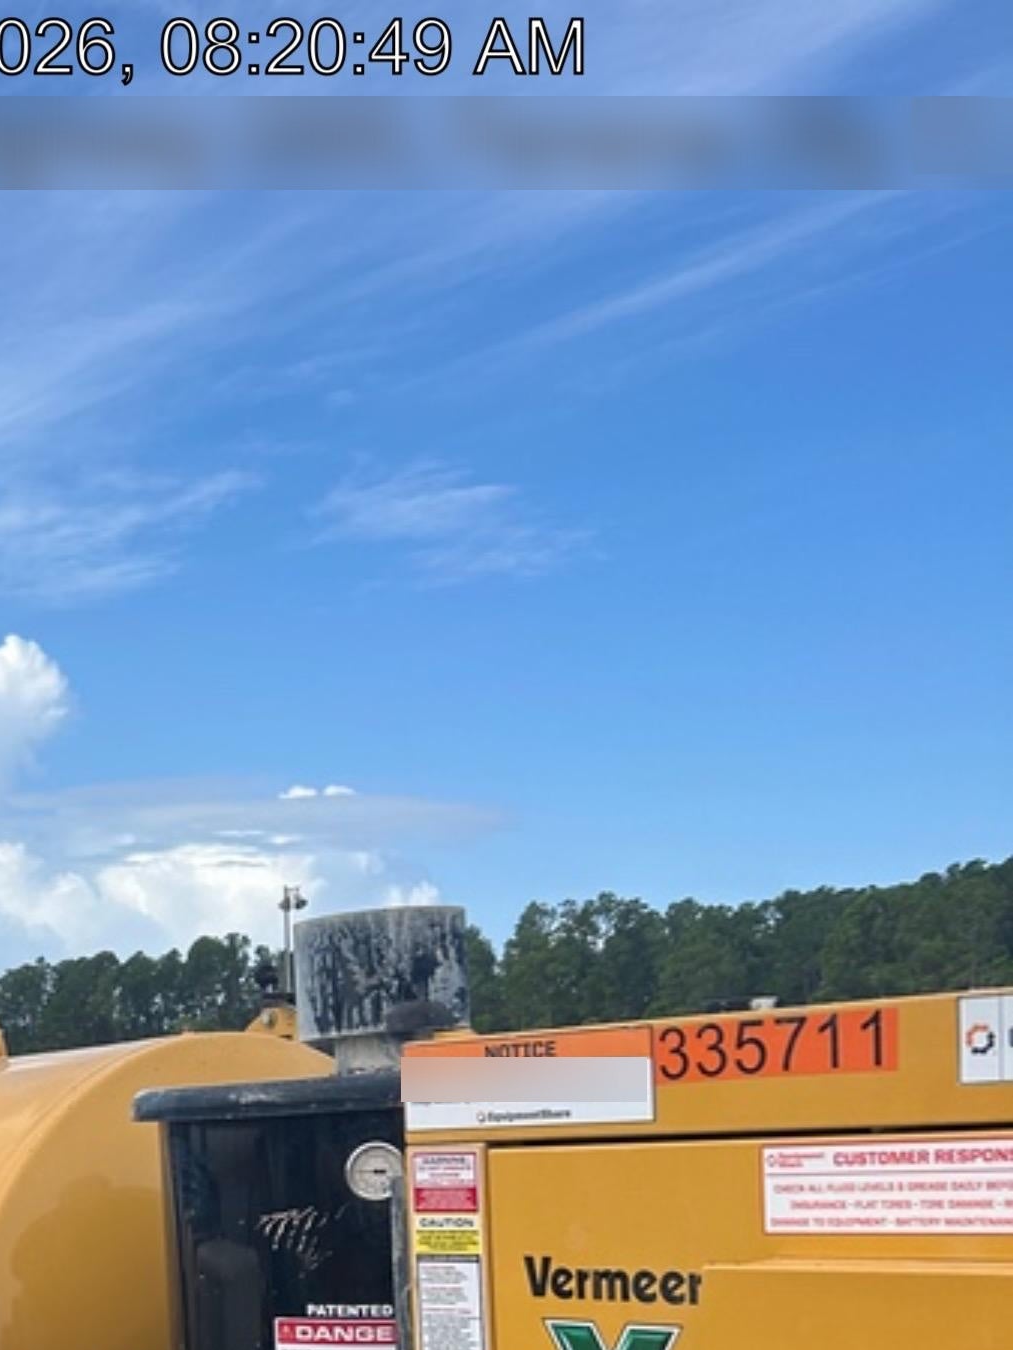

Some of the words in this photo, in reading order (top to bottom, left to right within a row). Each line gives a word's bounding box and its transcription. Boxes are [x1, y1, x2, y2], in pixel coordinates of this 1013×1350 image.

[484, 1041, 556, 1058] NOTICE
[659, 1008, 883, 1080] 335711
[833, 1151, 930, 1167] CUSTOMER
[419, 1217, 475, 1228] CAUTION
[523, 1255, 702, 1305] Vermeer
[307, 1303, 394, 1317] PATENTED
[294, 1325, 395, 1342] DANGE
